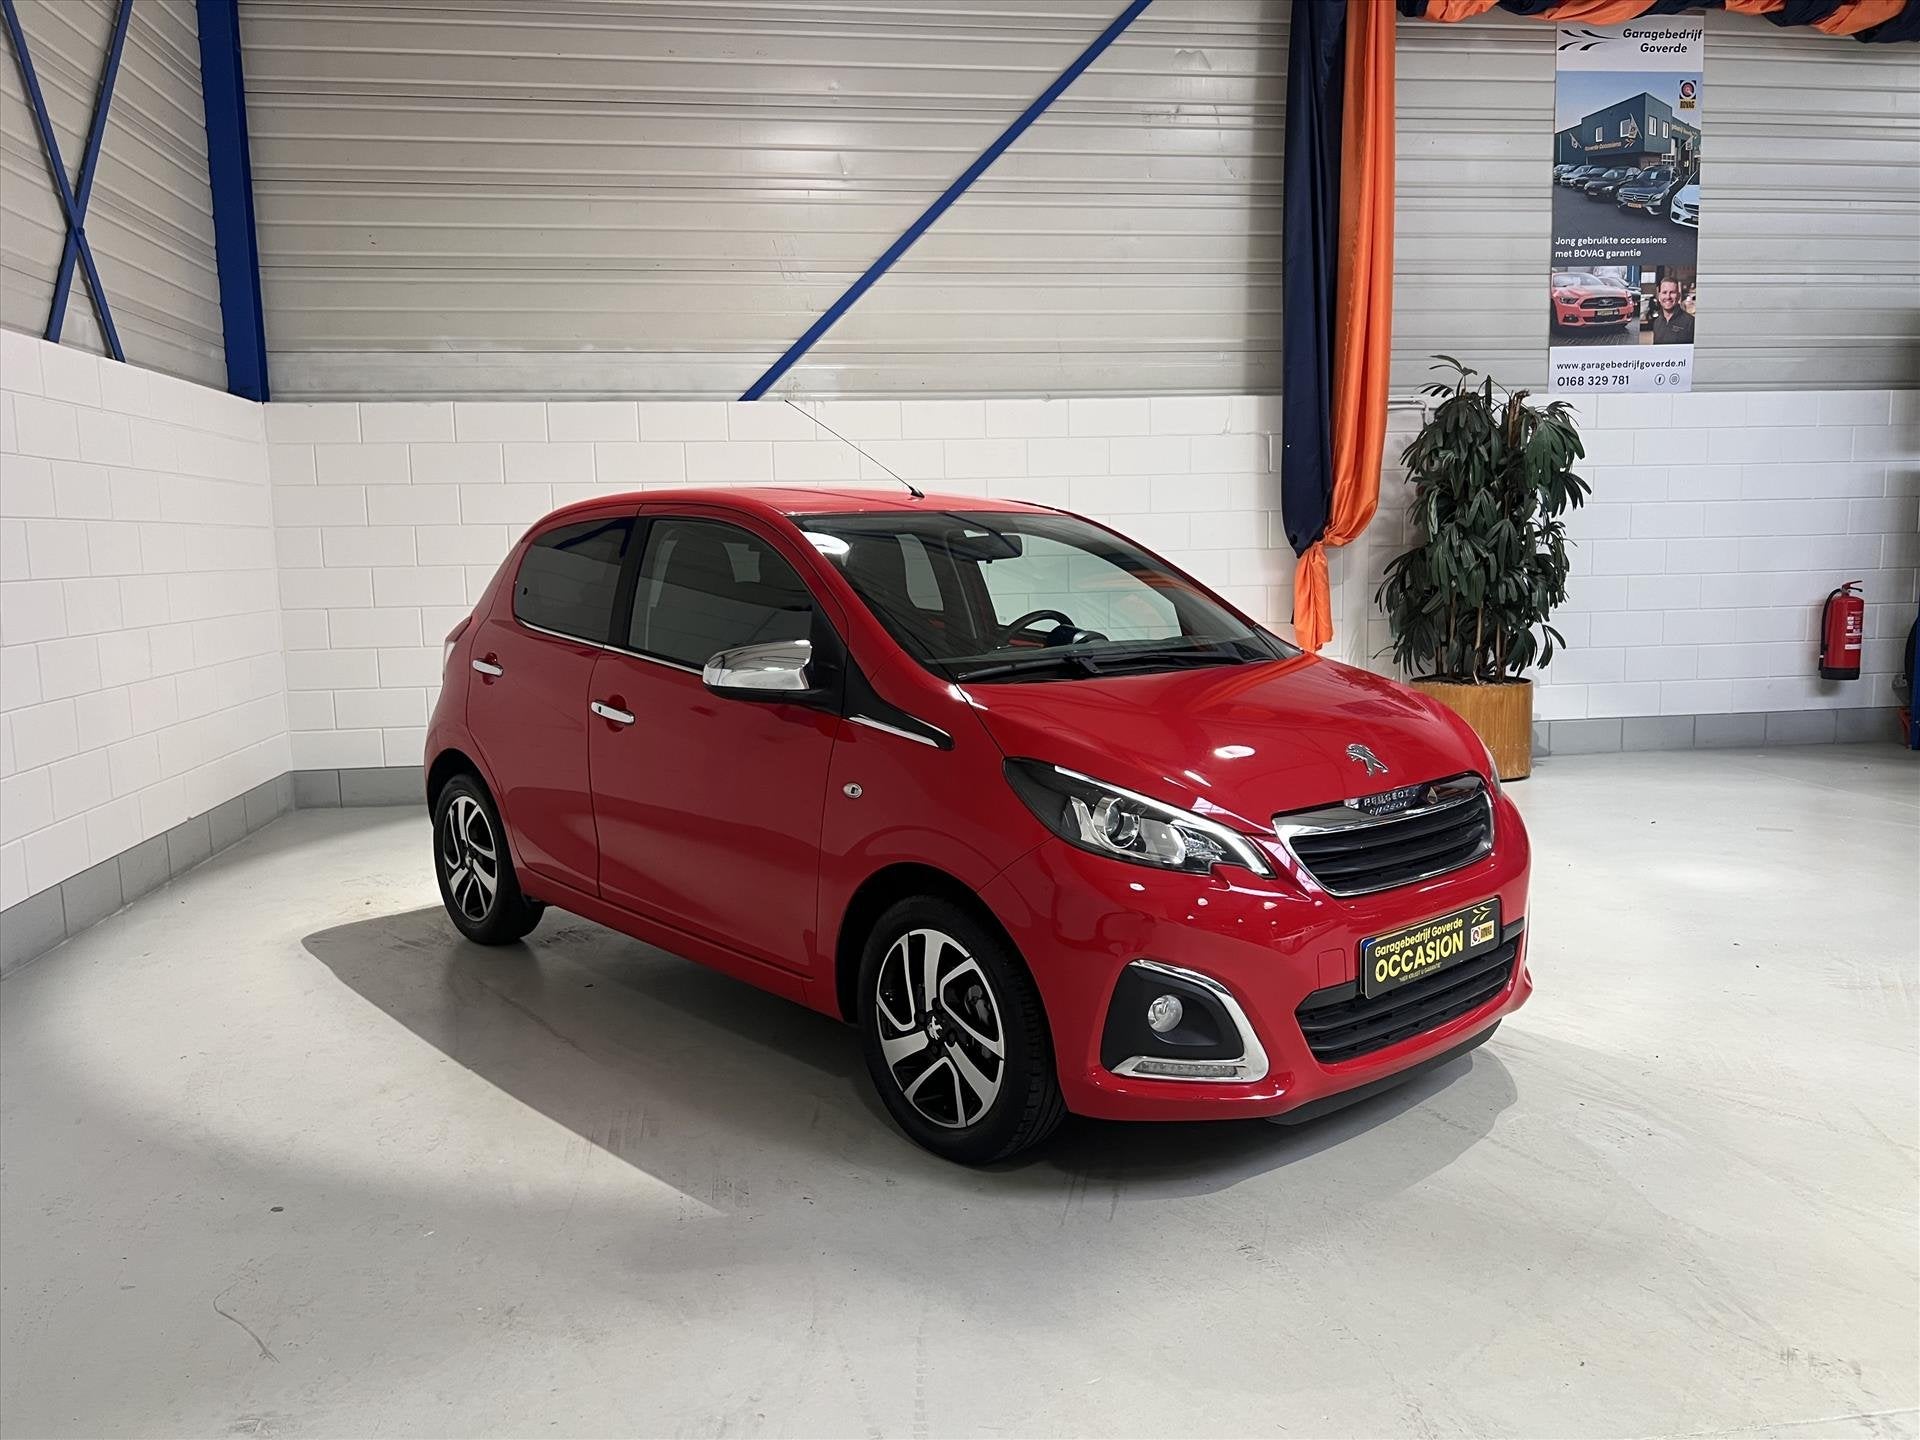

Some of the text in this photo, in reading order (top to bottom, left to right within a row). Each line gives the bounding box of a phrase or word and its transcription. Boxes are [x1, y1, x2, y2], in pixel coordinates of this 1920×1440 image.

[1622, 28, 1703, 41] Garagebedrijf
[1640, 43, 1688, 53] Goverde
[1555, 237, 1575, 247] Jong
[1577, 236, 1618, 246] gebruikte
[1574, 249, 1605, 257] BOVAG
[1606, 248, 1642, 259] garantie
[1556, 359, 1686, 371] www.garagebedrijfgoverde.nl
[1557, 375, 1629, 386] 0168 329 781
[1364, 789, 1410, 806] PEUGEOT
[1375, 928, 1431, 958] Garagebedrijf
[1431, 918, 1463, 937] Goverde
[1375, 930, 1464, 983] OCCASION
